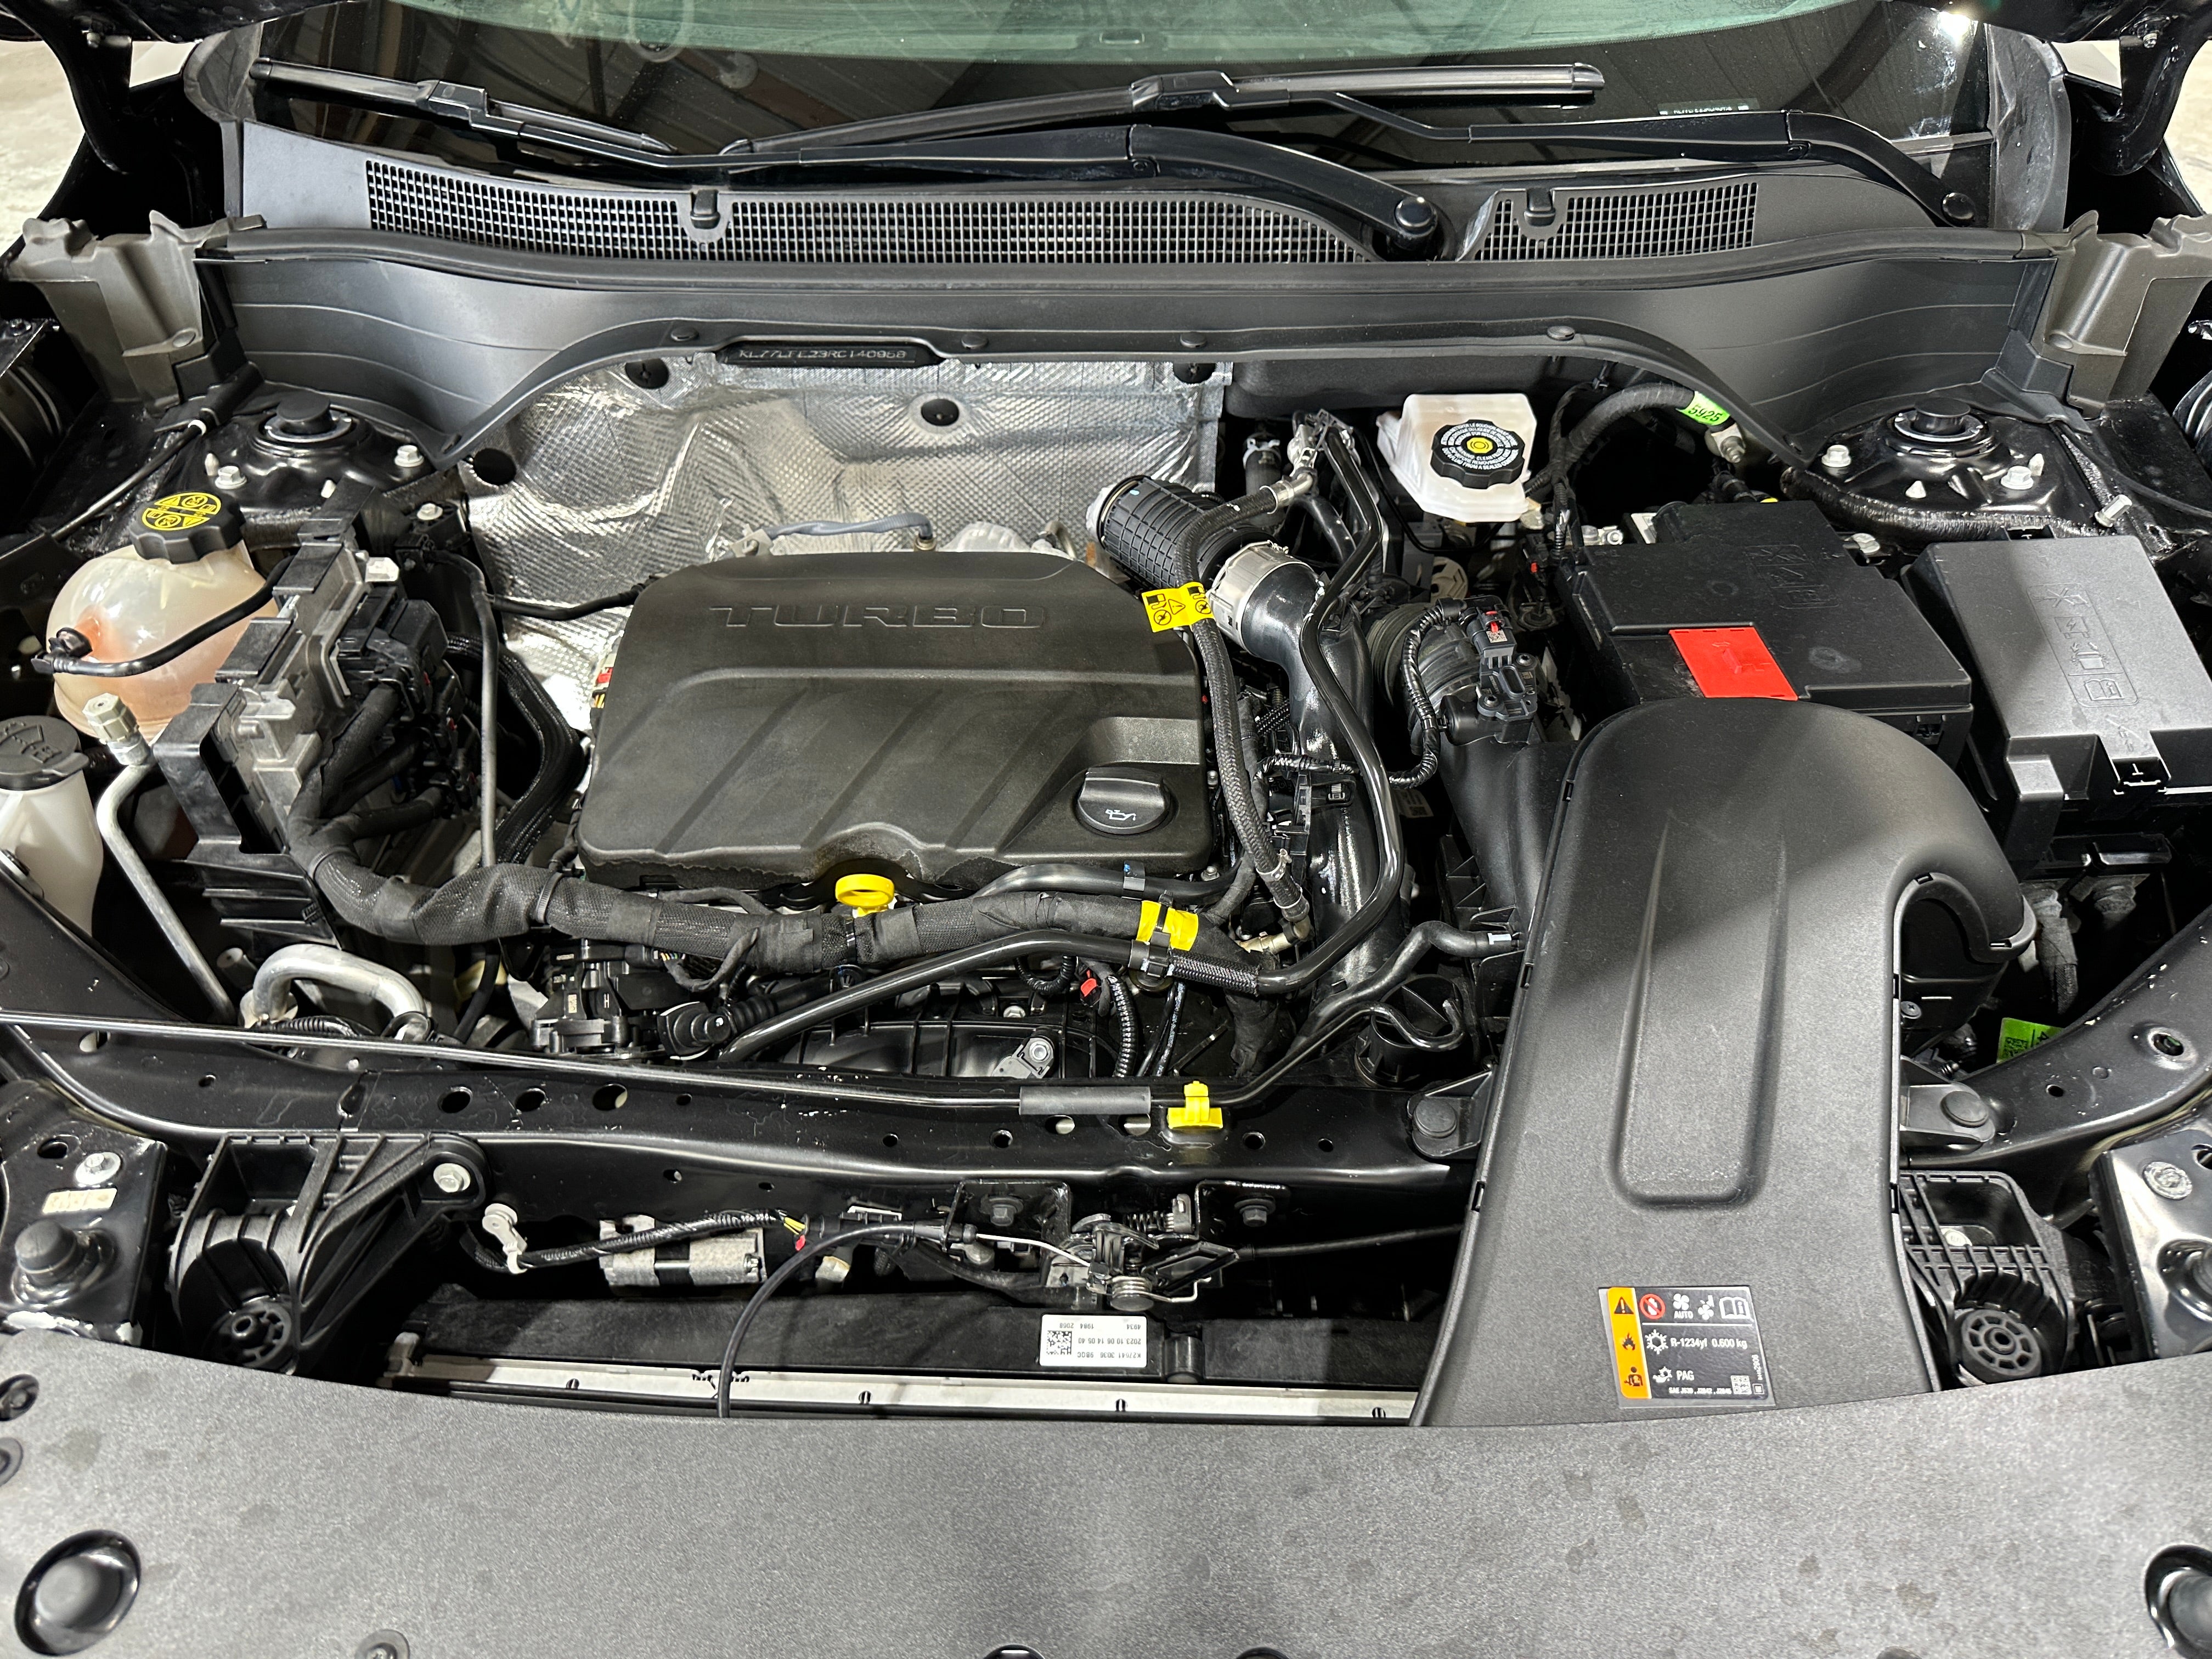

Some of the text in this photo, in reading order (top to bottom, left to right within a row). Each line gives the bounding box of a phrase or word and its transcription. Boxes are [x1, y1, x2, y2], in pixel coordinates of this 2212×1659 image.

[1688, 403, 1723, 422] 5925
[709, 605, 1045, 628] TURBO
[1674, 1311, 1694, 1319] AUTO
[1670, 1338, 1748, 1350] R-1234yf 0.600 kg
[1676, 1370, 1695, 1381] PAG
